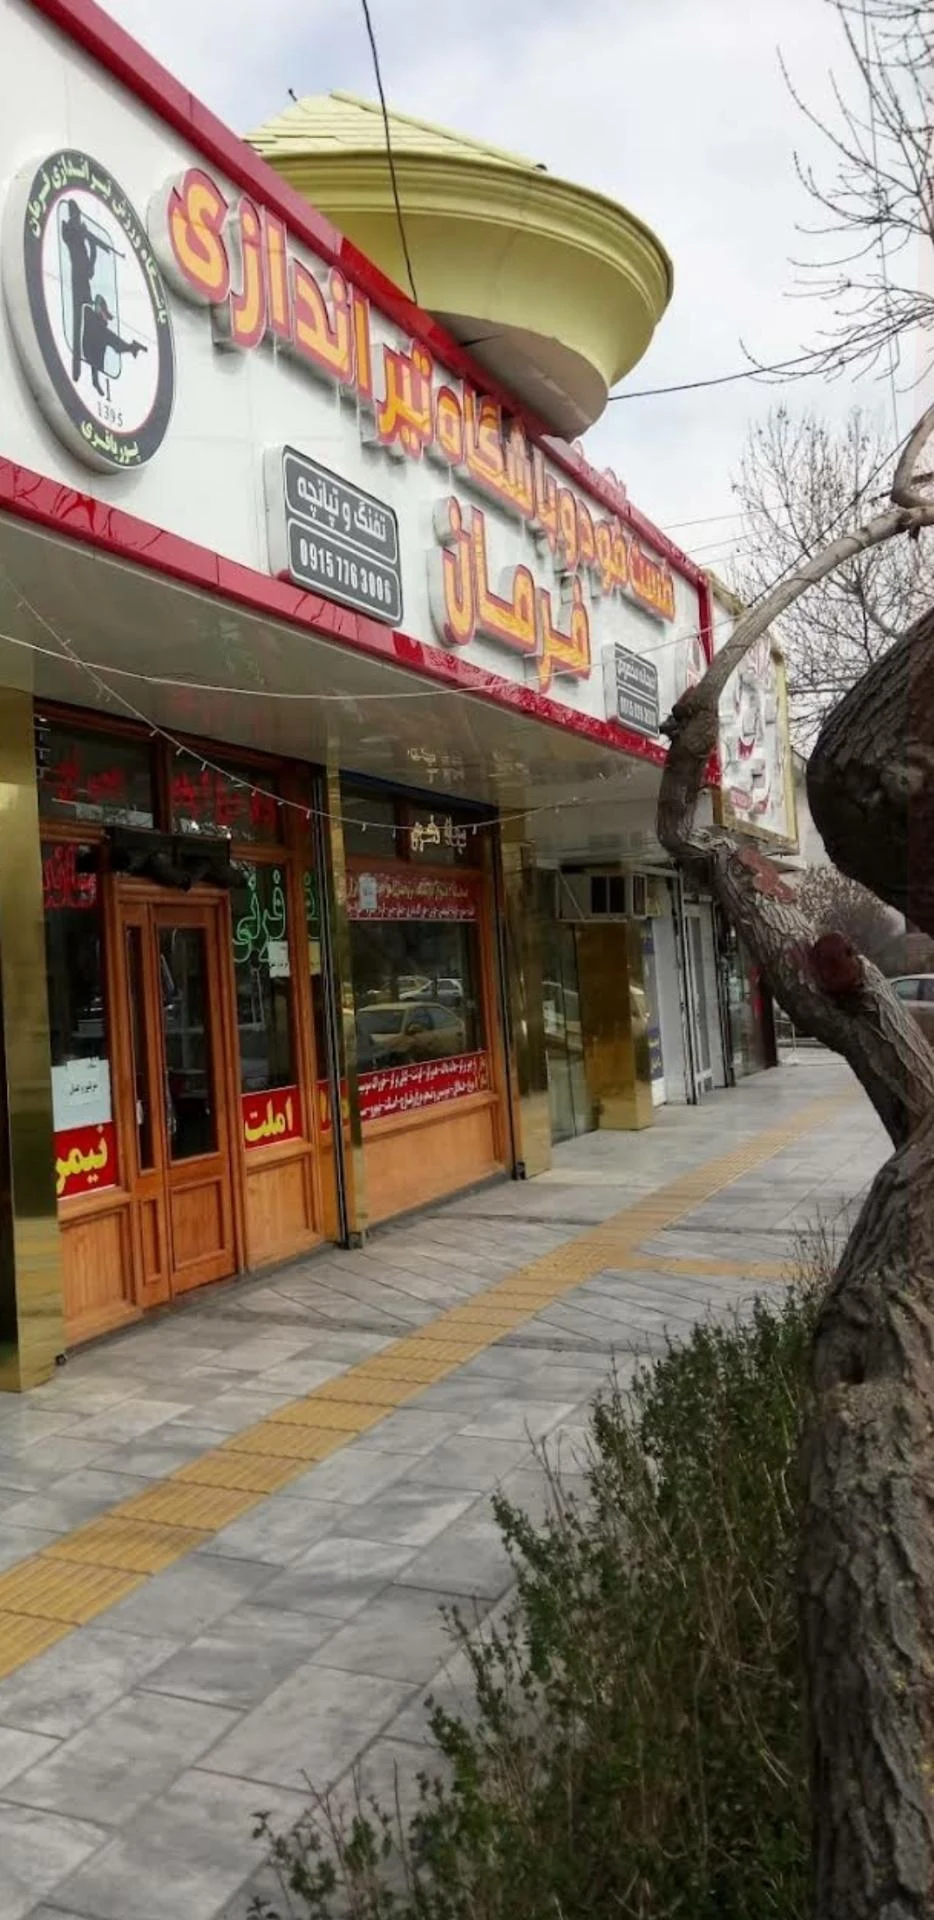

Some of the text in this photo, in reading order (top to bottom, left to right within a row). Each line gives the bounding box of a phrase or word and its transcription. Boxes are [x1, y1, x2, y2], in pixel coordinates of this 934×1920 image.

[97, 401, 124, 428] 1395
[297, 475, 387, 543] تفنگ و تپانچه
[441, 494, 591, 694] فرمان
[245, 1095, 294, 1143] املت
[55, 1125, 108, 1196] نیمر
